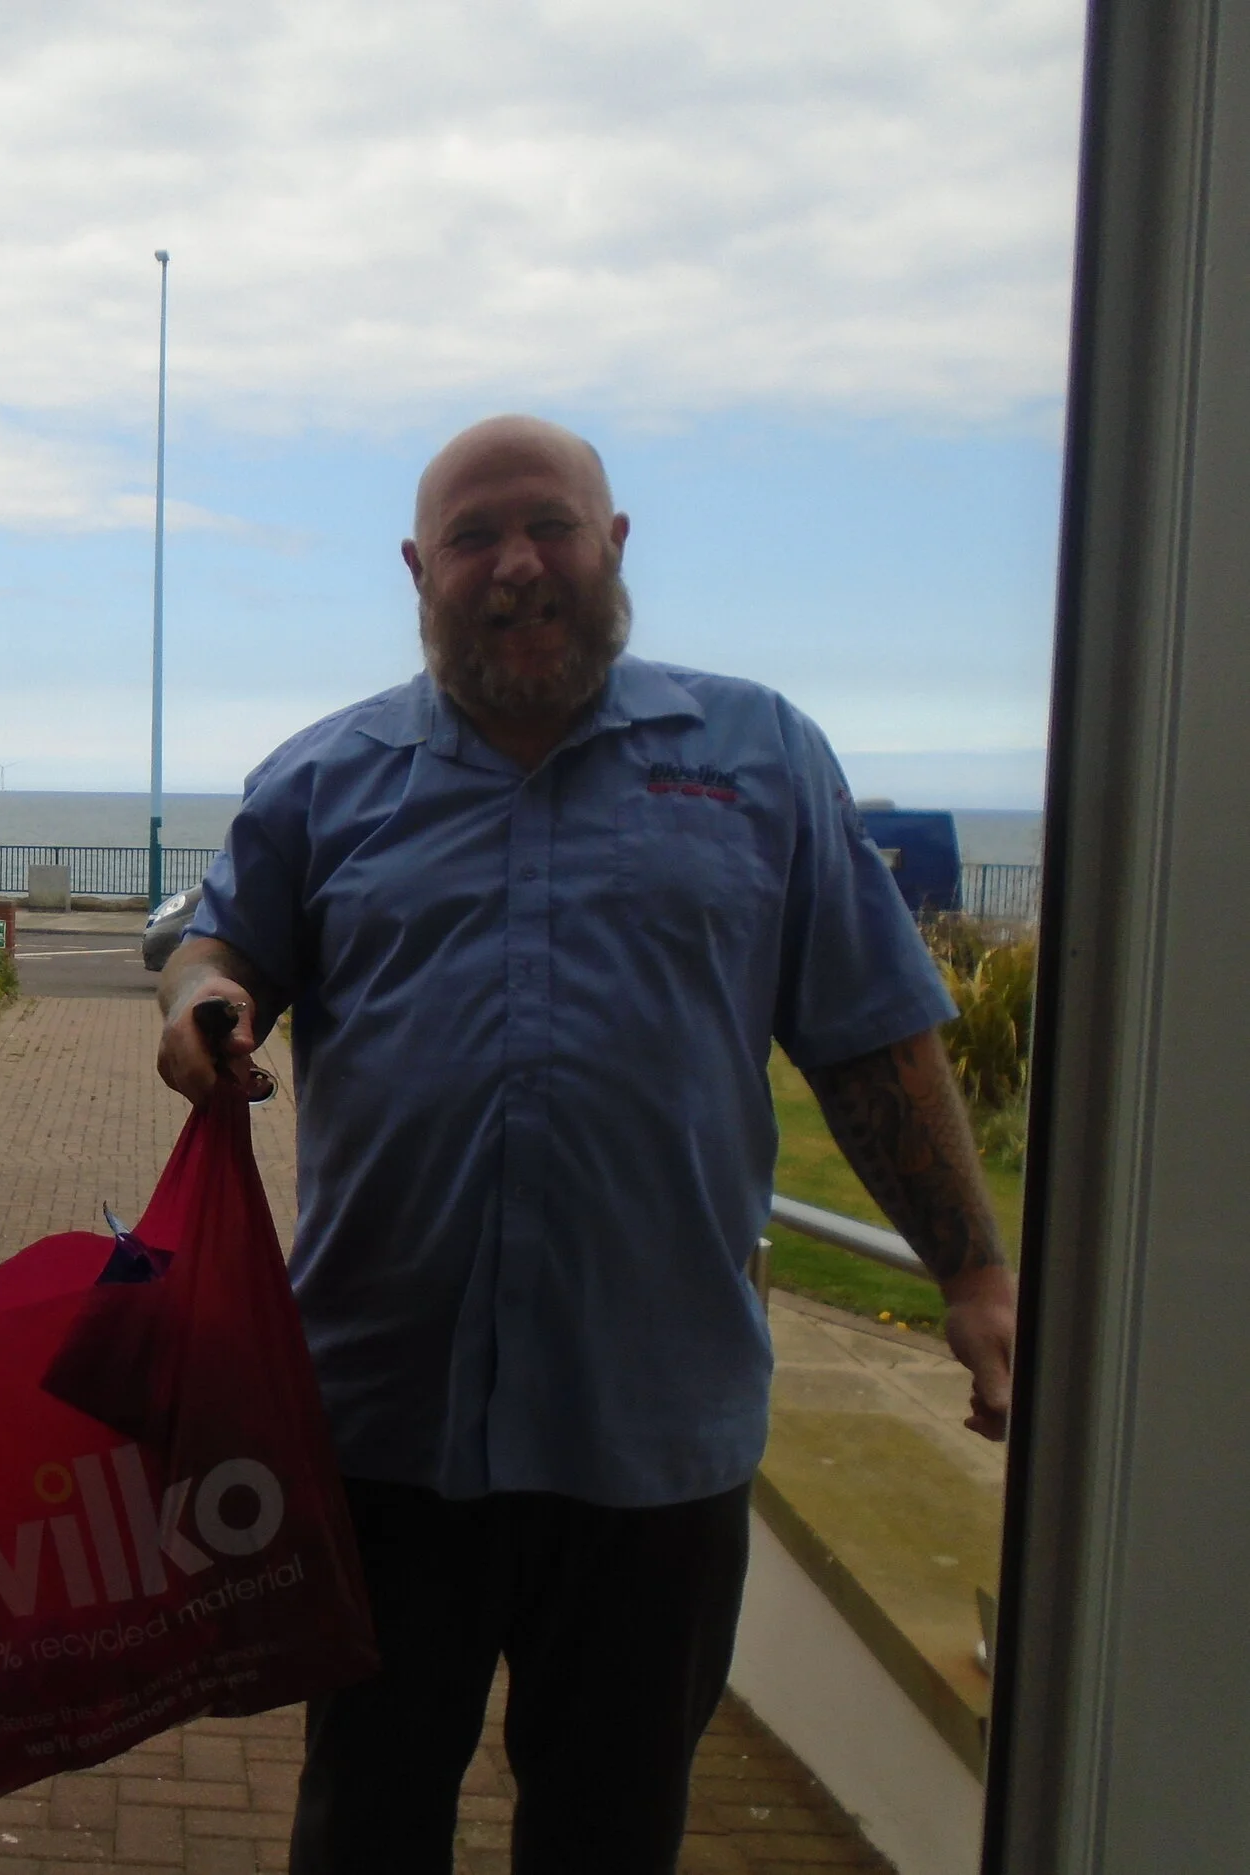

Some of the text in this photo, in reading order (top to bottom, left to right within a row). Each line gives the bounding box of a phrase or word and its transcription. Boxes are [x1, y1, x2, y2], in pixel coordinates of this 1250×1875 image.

[30, 1614, 169, 1660] recycled
[177, 1553, 305, 1625] material
[24, 1733, 72, 1758] we'll
[76, 1696, 177, 1750] exchange
[59, 1705, 96, 1724] this
